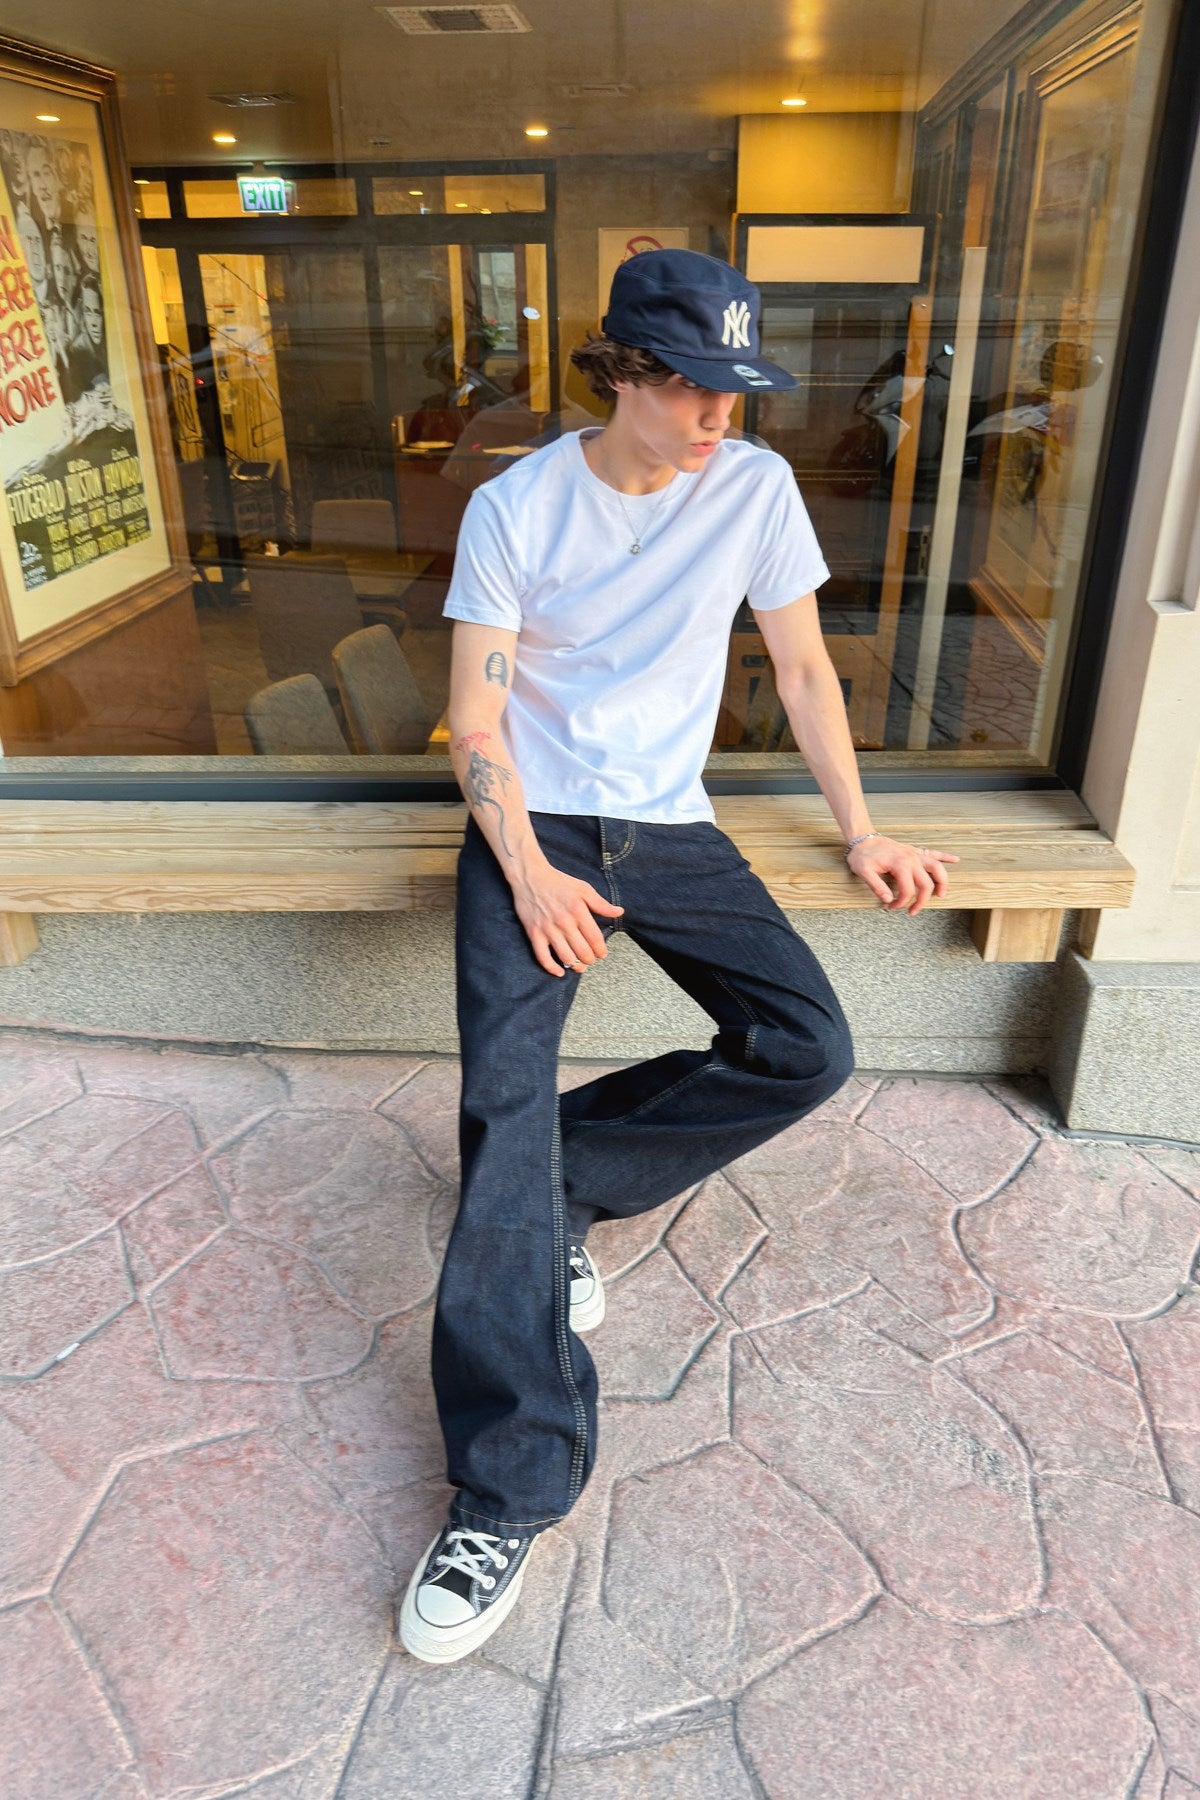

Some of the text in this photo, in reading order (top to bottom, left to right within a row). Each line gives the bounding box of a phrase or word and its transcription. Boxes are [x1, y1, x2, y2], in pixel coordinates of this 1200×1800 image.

[242, 183, 281, 210] EXIT
[0, 266, 35, 318] RE
[0, 318, 45, 379] ERE
[721, 300, 752, 349] NY
